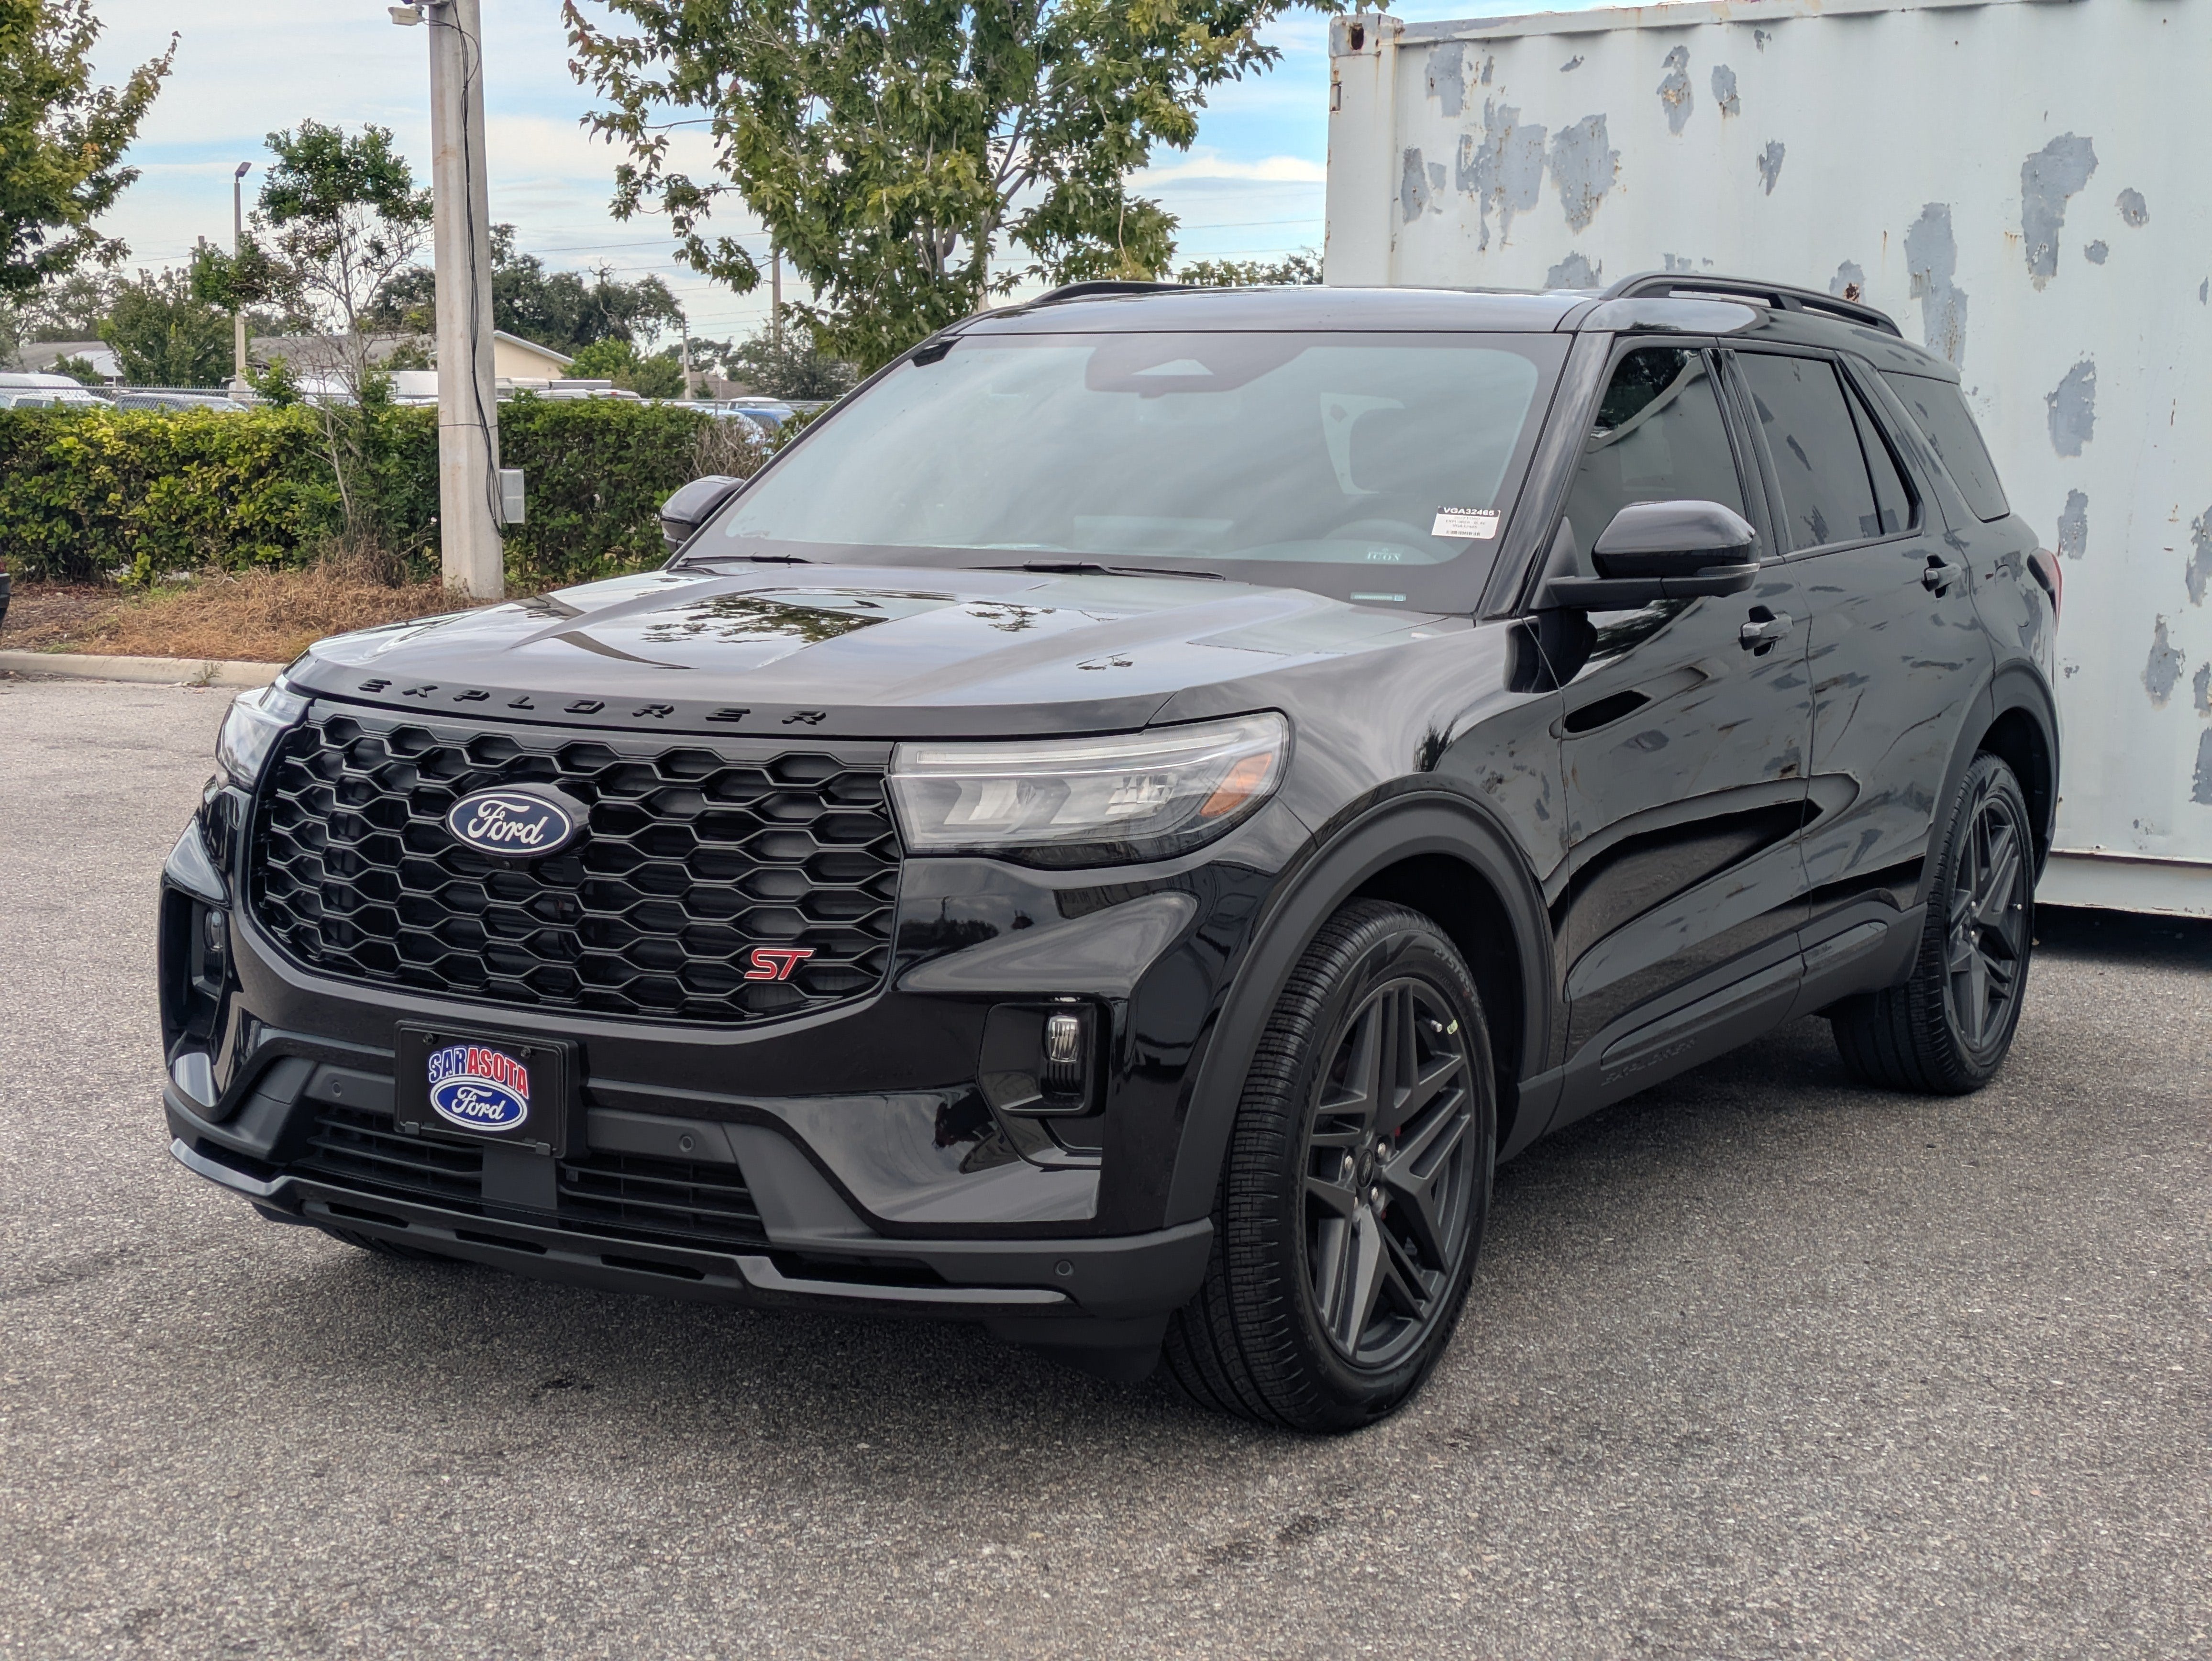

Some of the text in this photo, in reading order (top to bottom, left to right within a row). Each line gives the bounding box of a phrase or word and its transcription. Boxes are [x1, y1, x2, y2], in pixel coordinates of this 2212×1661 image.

[358, 678, 826, 725] EXPLORER
[467, 800, 549, 845] Ford
[744, 948, 815, 980] ST
[429, 1046, 529, 1100] SARASOTA
[451, 1086, 507, 1120] Ford
